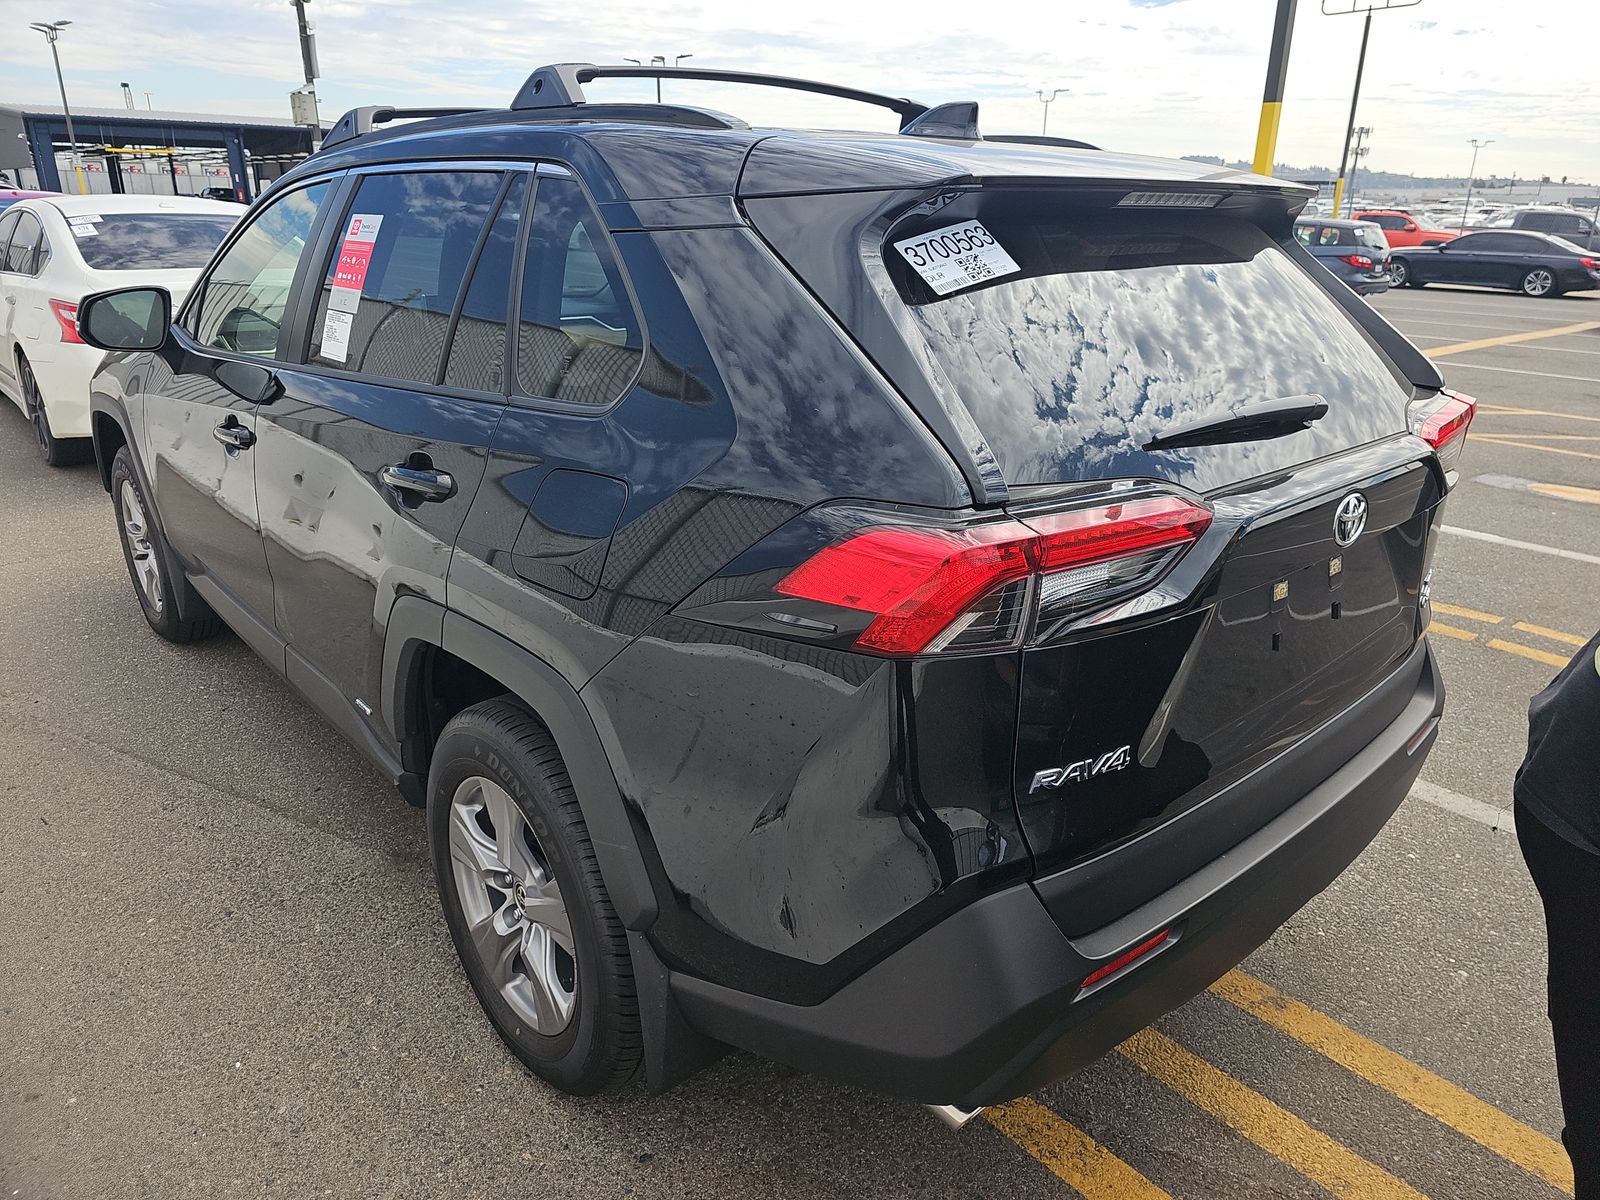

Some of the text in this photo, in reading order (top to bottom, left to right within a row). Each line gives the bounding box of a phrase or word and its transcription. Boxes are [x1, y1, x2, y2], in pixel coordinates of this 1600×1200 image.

[904, 226, 995, 267] 3700563
[925, 272, 946, 283] DLR
[1028, 745, 1130, 794] RAV4
[485, 752, 563, 865] DUNLOP
